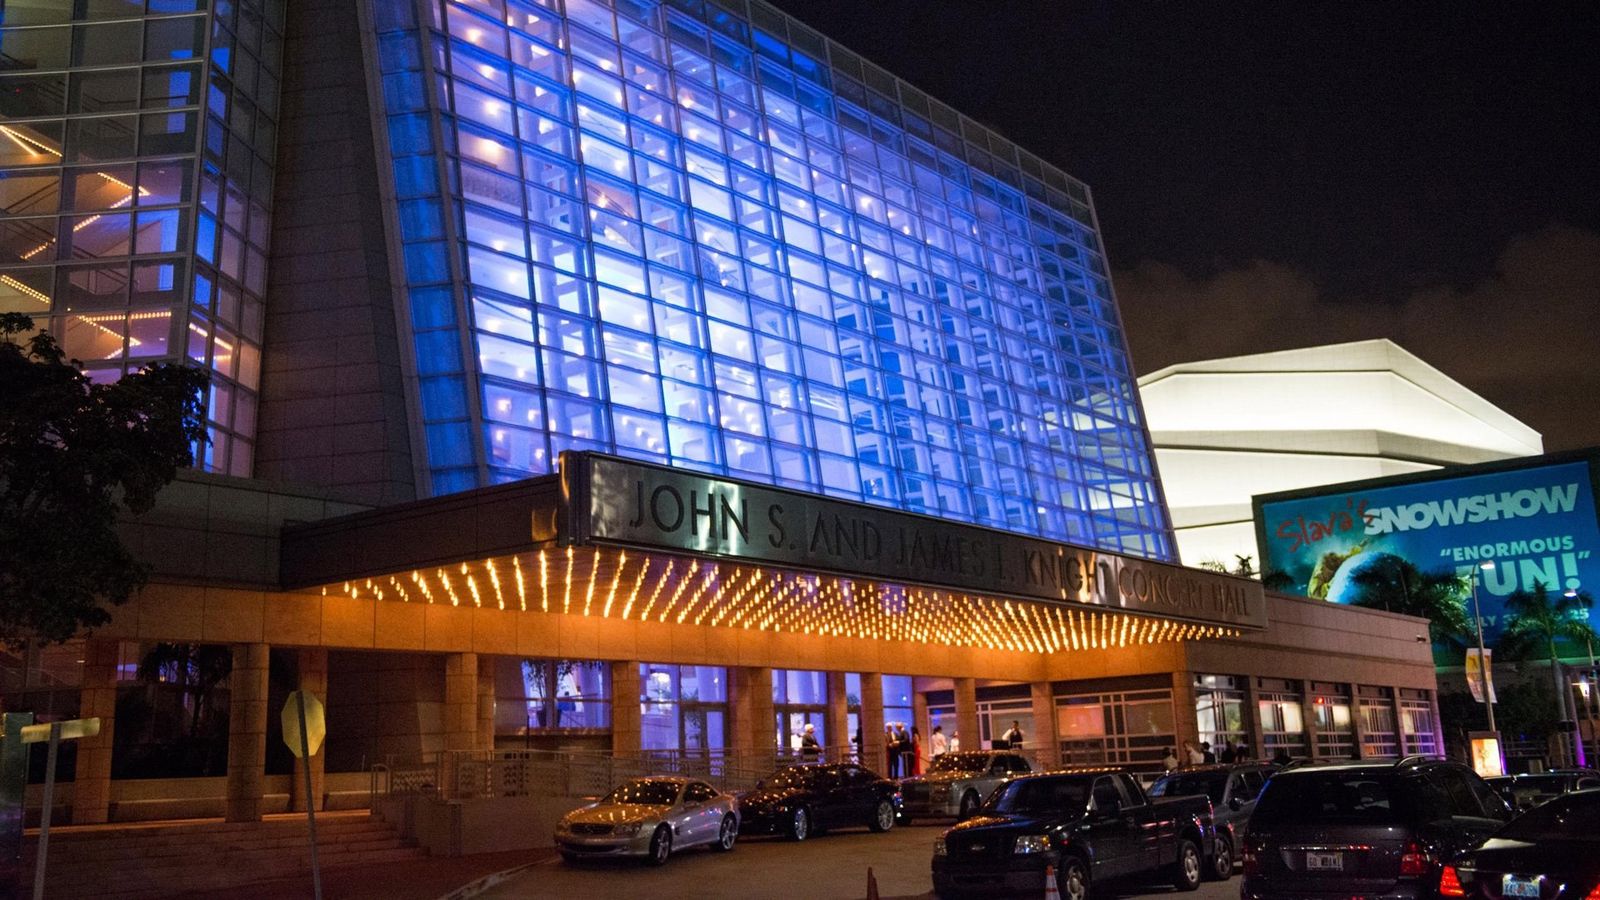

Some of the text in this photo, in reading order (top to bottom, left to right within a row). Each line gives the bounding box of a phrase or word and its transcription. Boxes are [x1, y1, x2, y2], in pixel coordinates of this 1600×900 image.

[630, 481, 749, 544] JOHN
[768, 504, 796, 549] S.
[811, 512, 882, 561] AND
[896, 527, 984, 576] JAMES
[1024, 549, 1110, 597] KNIGHT
[1211, 582, 1250, 616] HALL
[1277, 483, 1579, 552] Slava's SNOWSHOW
[1440, 535, 1575, 561] "ENORMOUS
